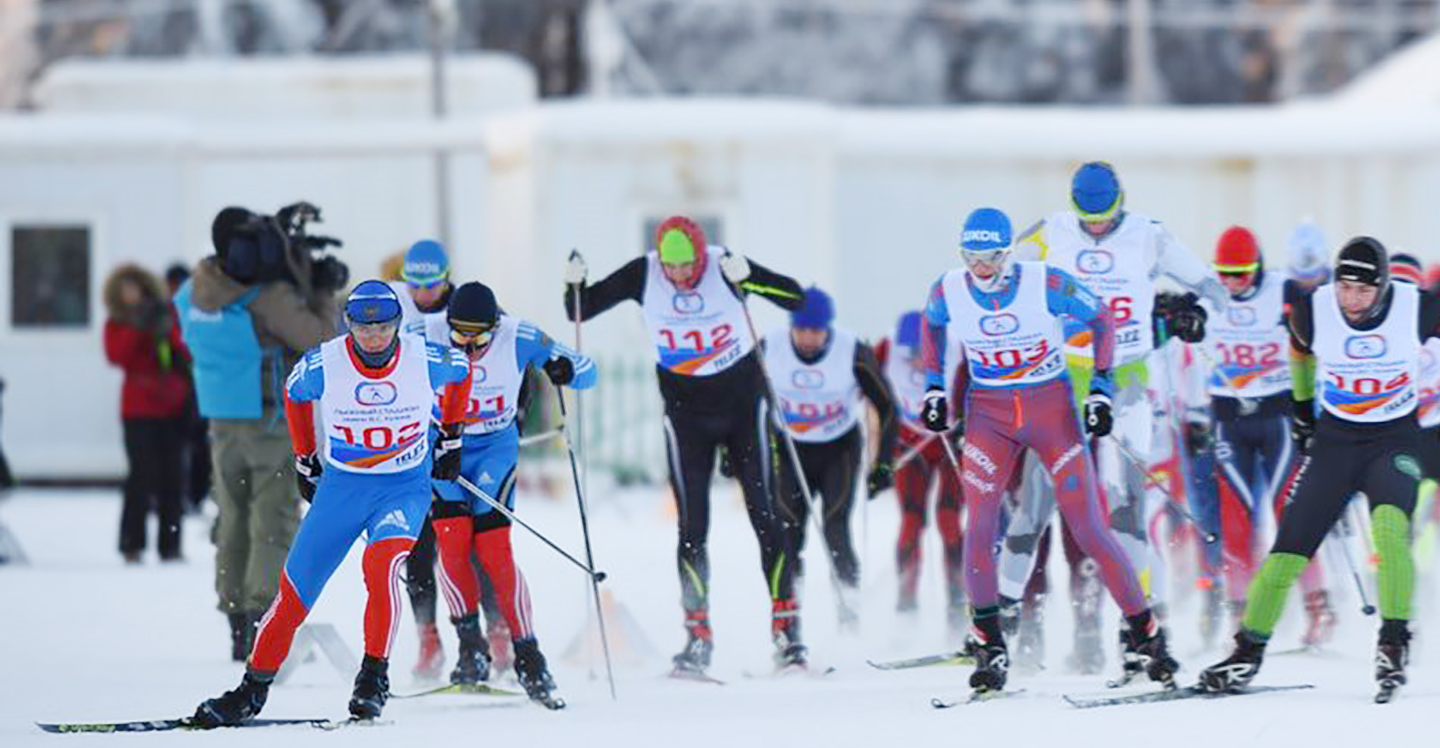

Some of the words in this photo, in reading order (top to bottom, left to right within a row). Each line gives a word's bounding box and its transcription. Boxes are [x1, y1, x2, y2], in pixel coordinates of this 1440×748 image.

[659, 324, 733, 351] 112
[969, 339, 1048, 368] 103
[1216, 342, 1280, 368] 182
[333, 421, 420, 449] 102
